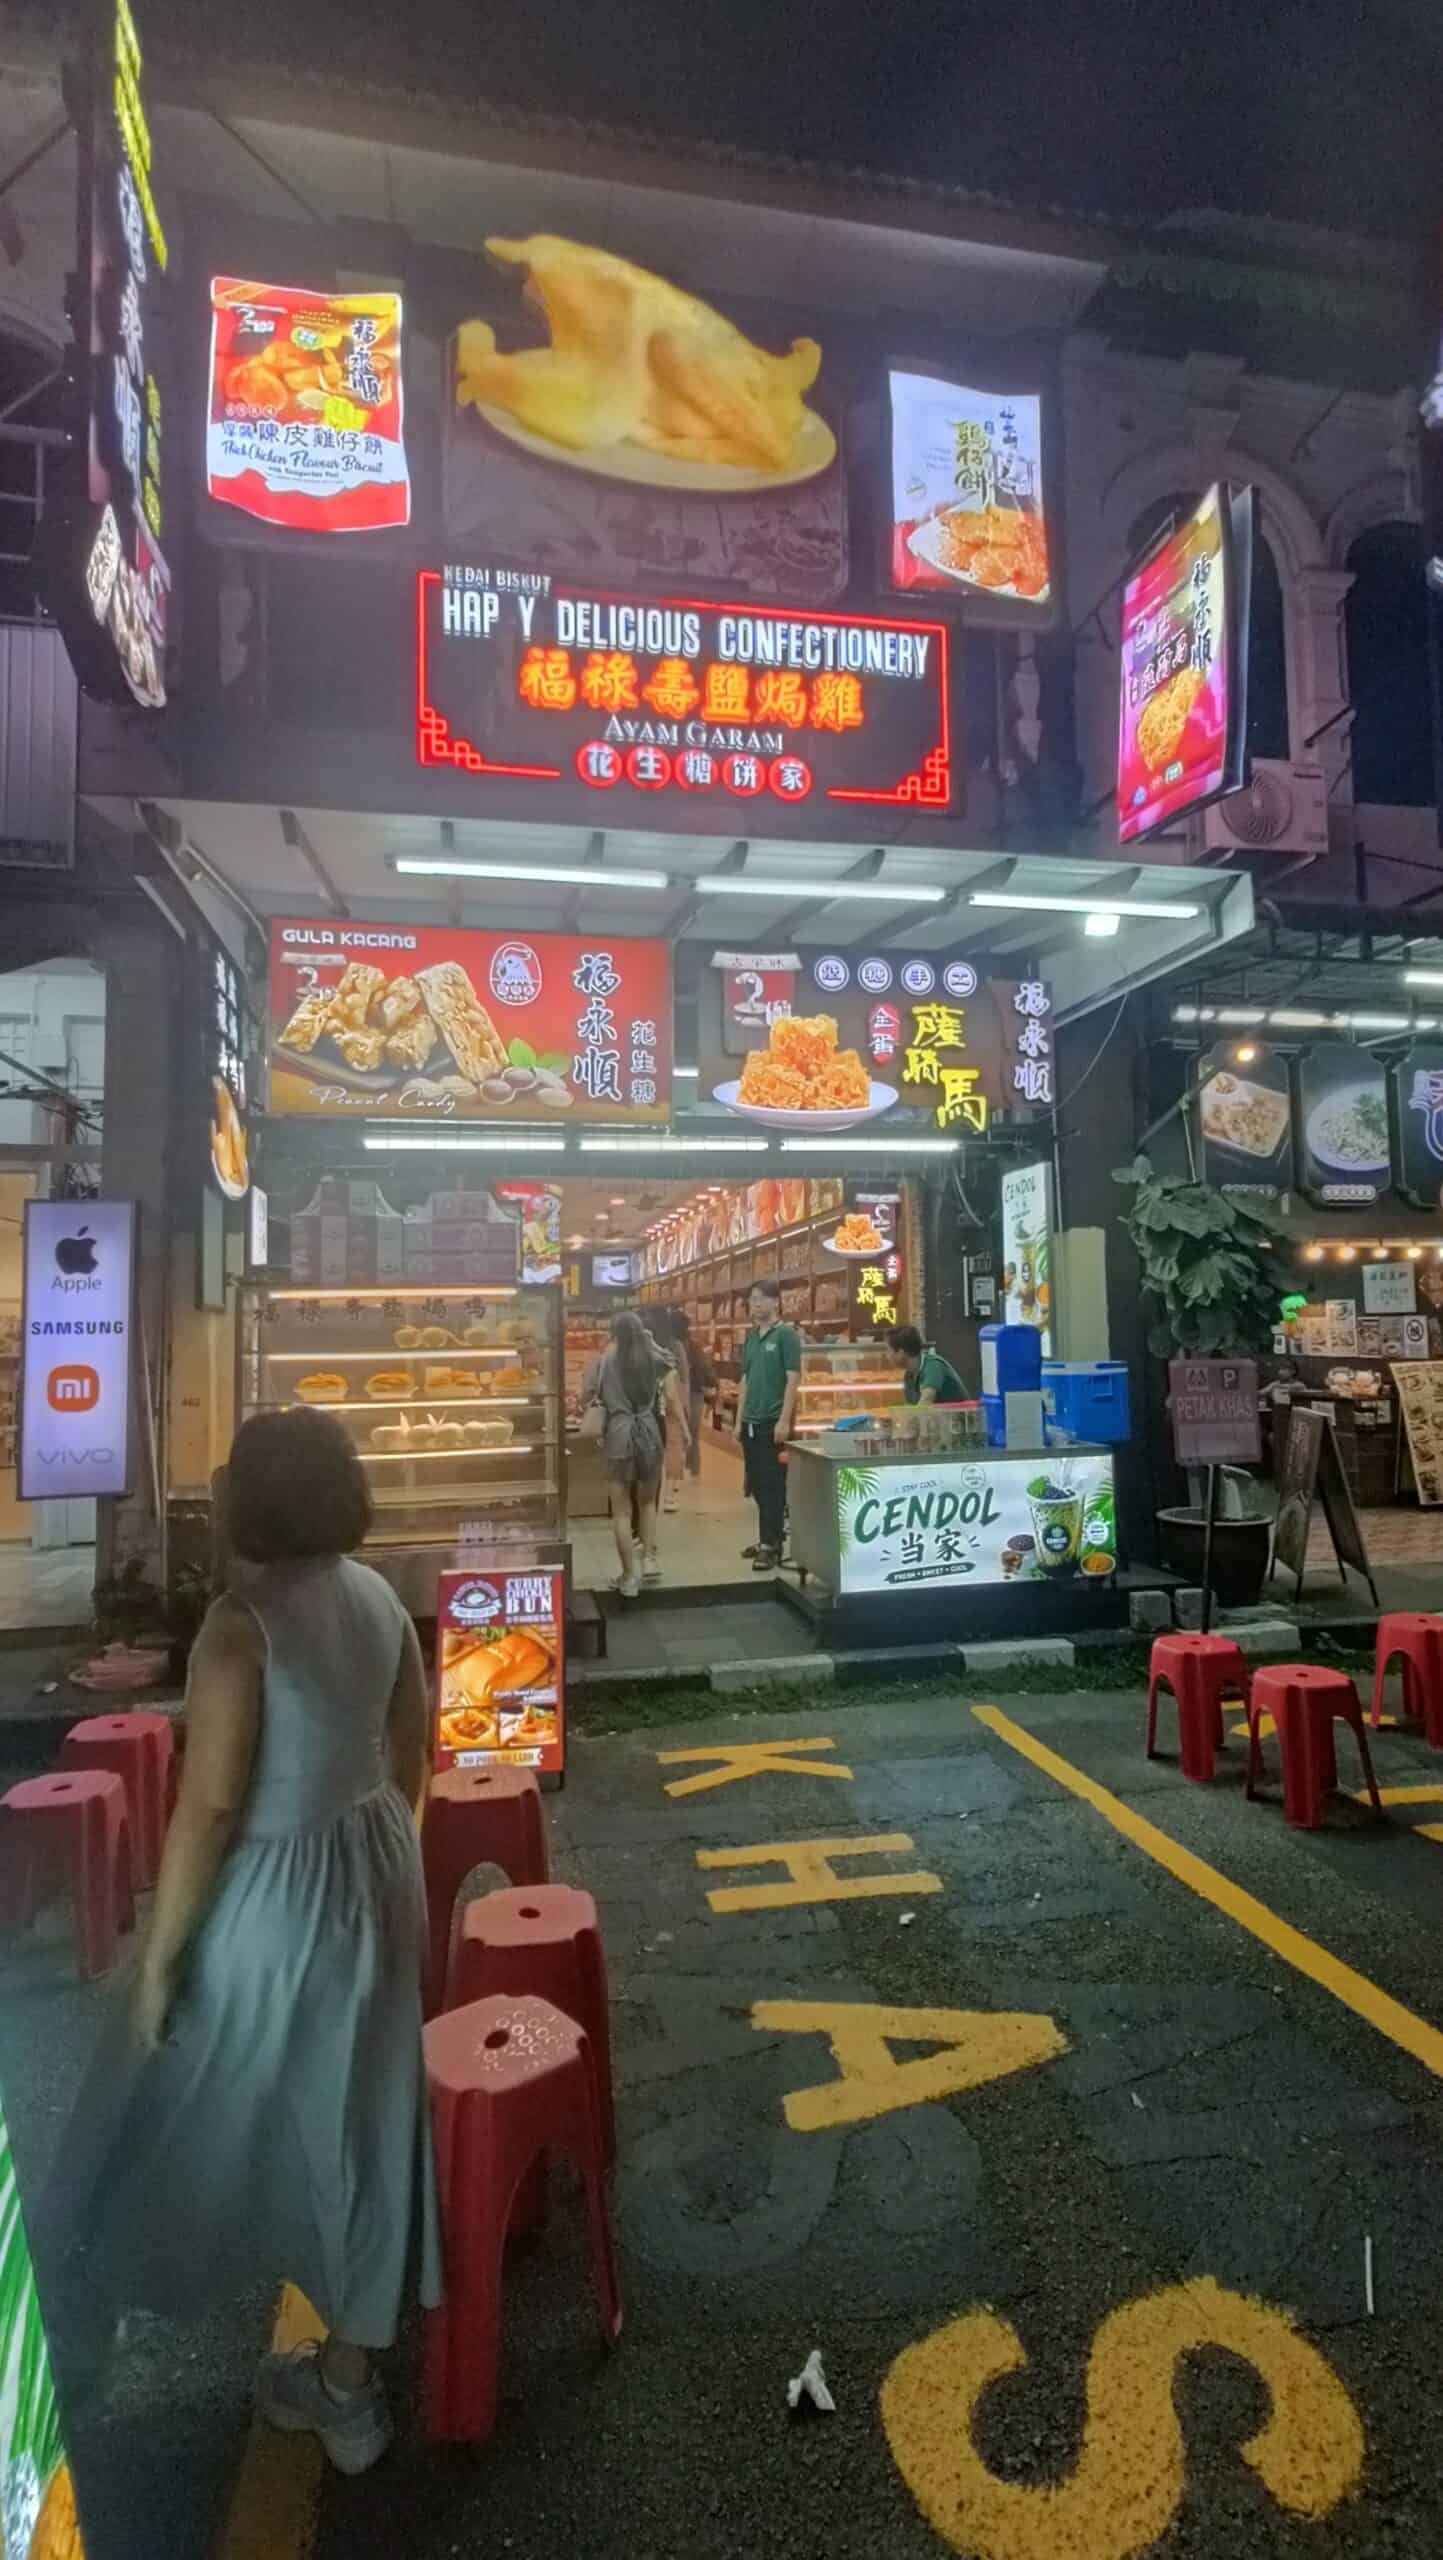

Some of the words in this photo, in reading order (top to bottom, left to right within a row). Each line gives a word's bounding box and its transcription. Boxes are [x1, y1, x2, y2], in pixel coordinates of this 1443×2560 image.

[290, 450, 340, 470] Flavour
[444, 565, 490, 587] KEDAI
[496, 569, 551, 594] BISKUT
[557, 599, 700, 658] DELICIOUS
[719, 617, 930, 678] CONFECTIONERY
[604, 714, 679, 745] AYAM
[686, 721, 784, 753] GARAM
[282, 929, 334, 944] GULA
[572, 952, 623, 1103] 福永順
[1012, 980, 1053, 1104] 福永順
[309, 1085, 388, 1105] Peanut
[398, 1088, 456, 1115] Candy
[51, 1275, 102, 1294] Apple
[31, 1320, 125, 1336] SAMSUNG
[37, 1447, 115, 1465] vivo
[854, 1487, 1001, 1545] CENDOL
[900, 1529, 966, 1565] 当家
[506, 1596, 552, 1614] BUN
